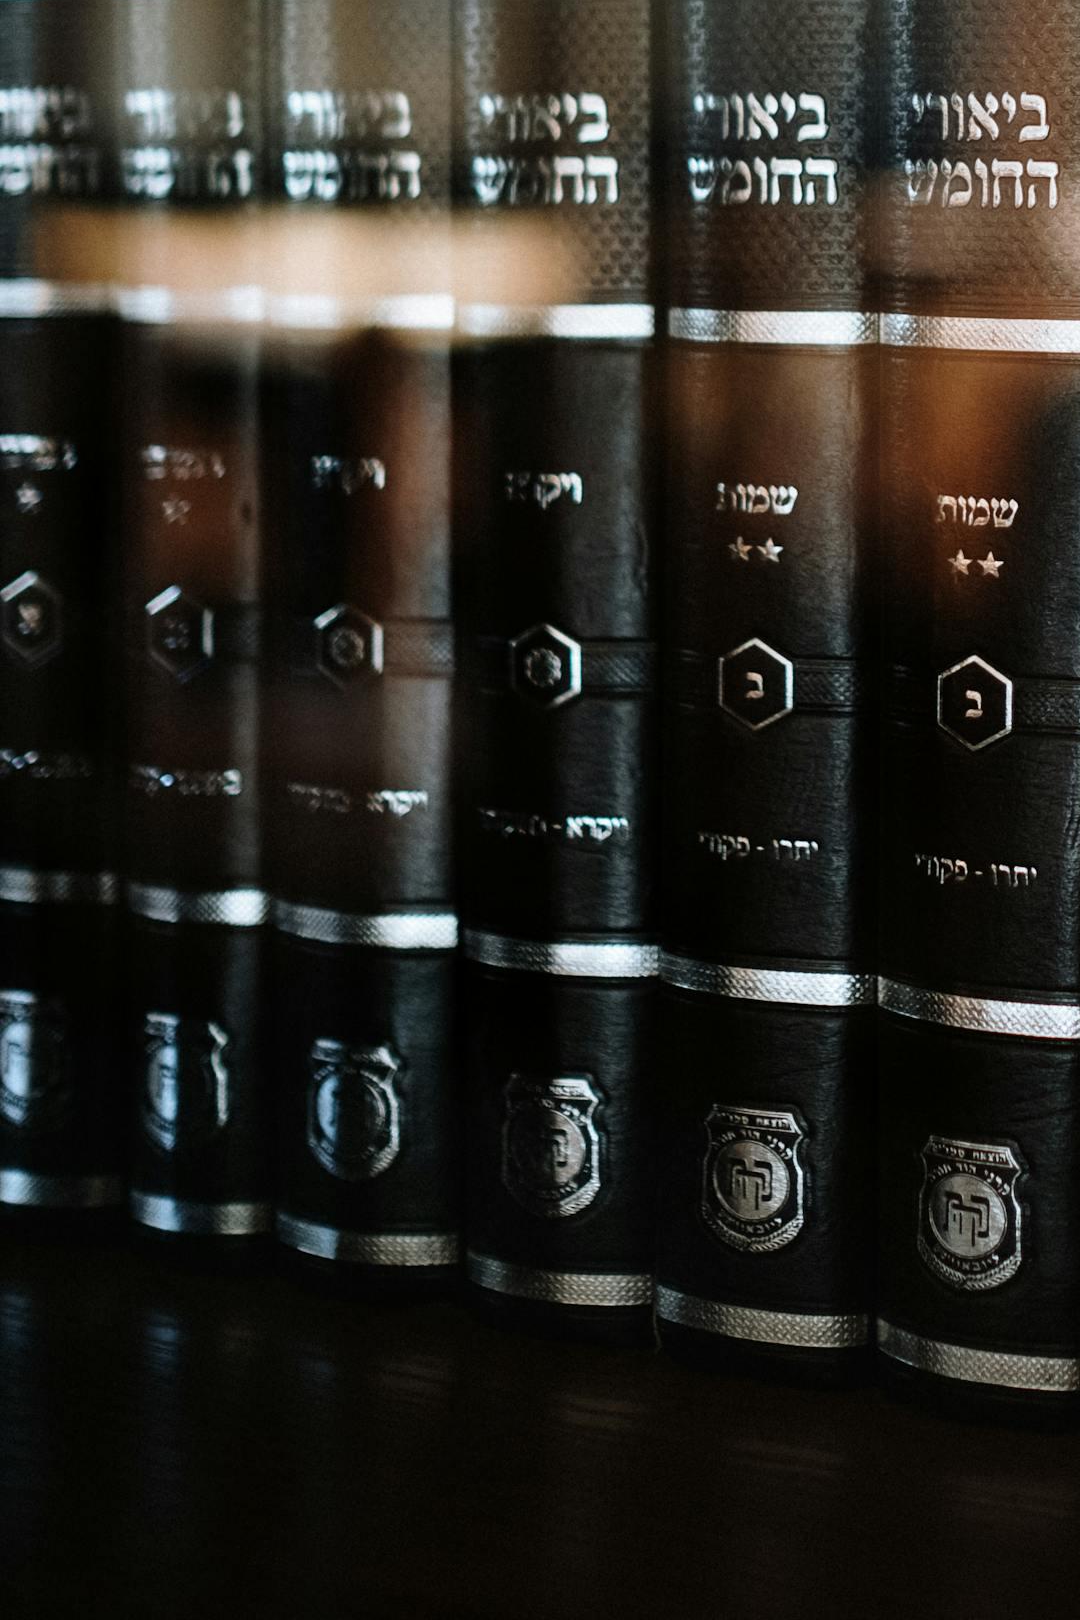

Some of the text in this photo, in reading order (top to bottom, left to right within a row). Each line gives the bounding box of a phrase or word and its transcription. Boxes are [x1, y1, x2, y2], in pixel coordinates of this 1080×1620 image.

[693, 91, 829, 142] ביאורי
[911, 90, 1049, 143] ביאורי
[471, 155, 619, 206] החש
[687, 155, 838, 206] החומש
[906, 156, 1059, 210] החומש
[505, 472, 583, 511] ויק
[935, 495, 1019, 528] שמות
[745, 671, 765, 699] ב
[964, 690, 983, 718] ב
